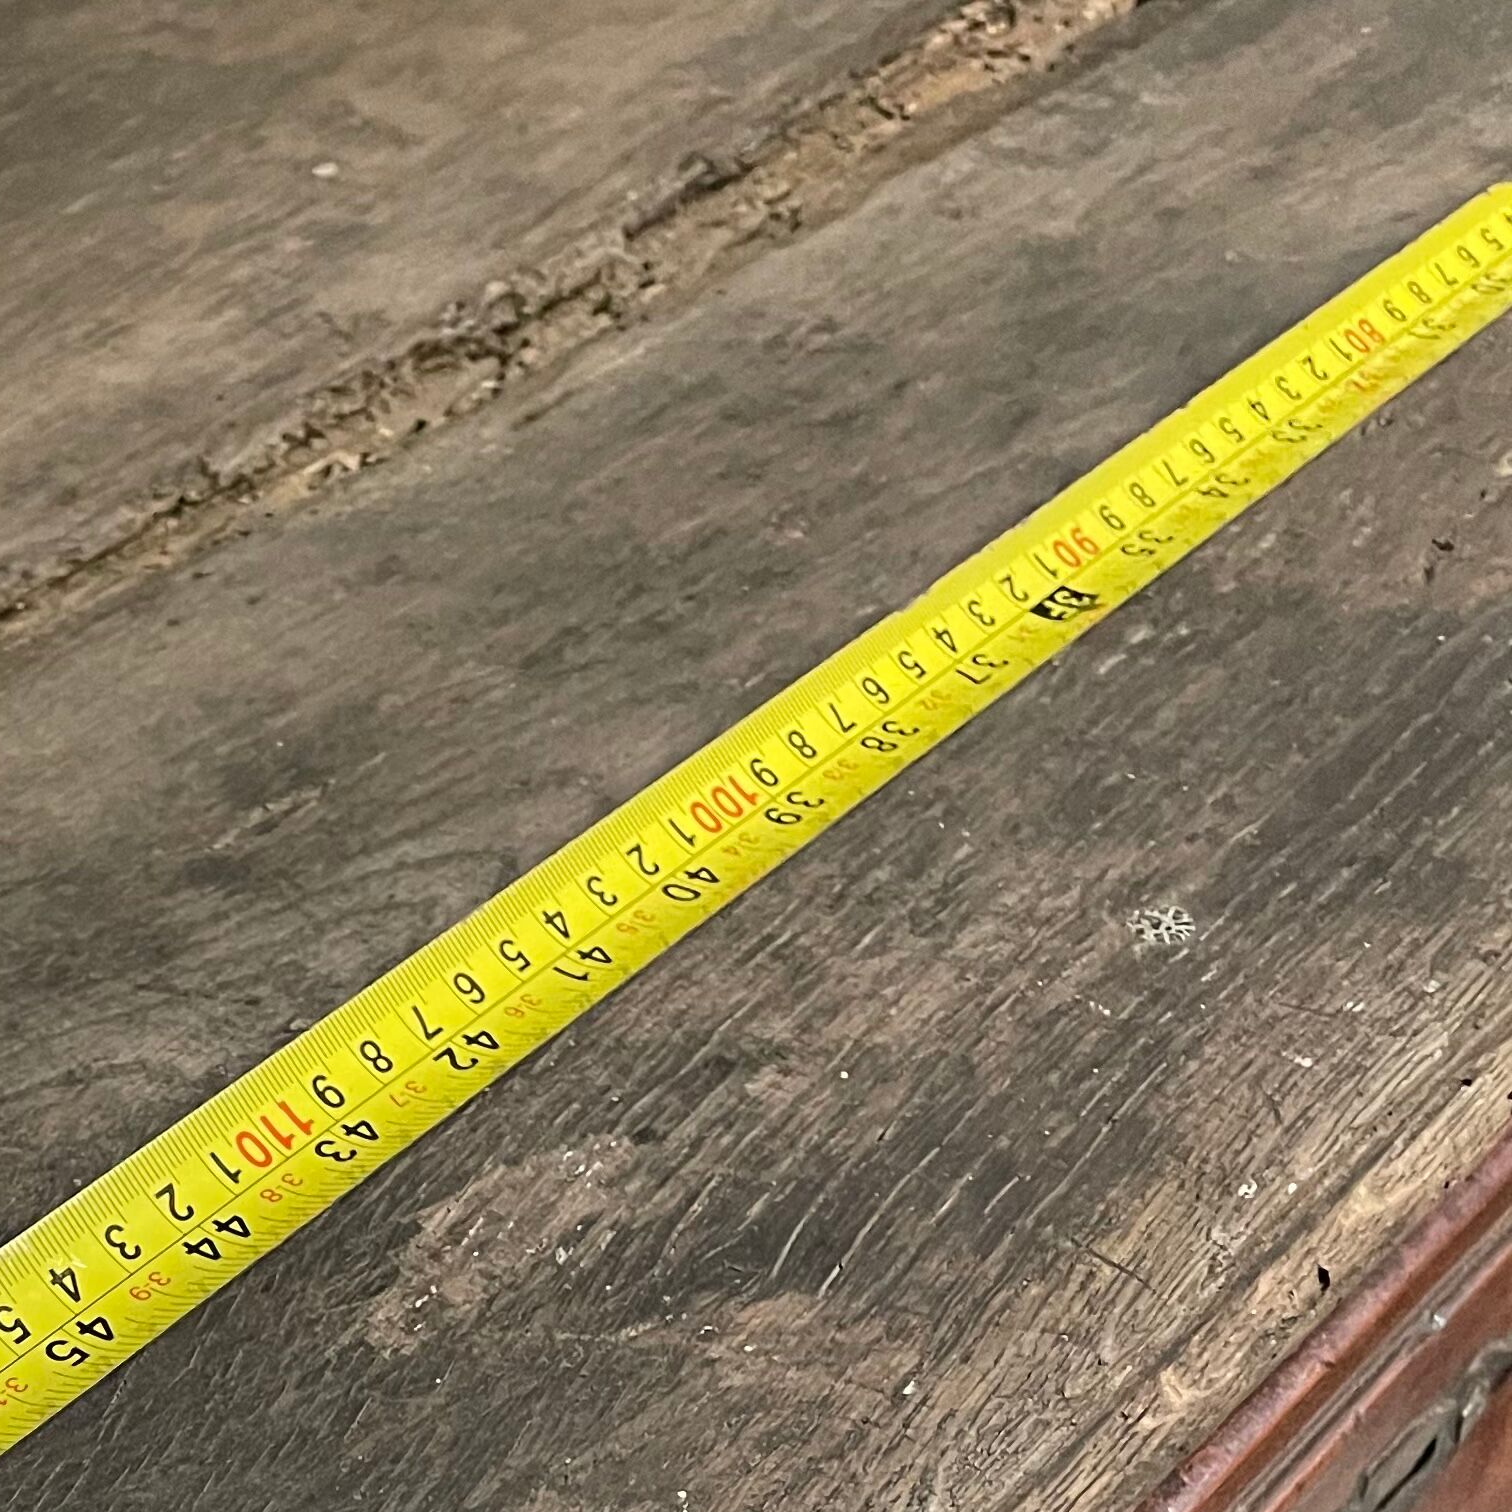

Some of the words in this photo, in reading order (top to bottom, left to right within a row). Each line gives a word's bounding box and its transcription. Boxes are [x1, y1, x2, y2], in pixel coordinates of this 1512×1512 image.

[1456, 245, 1481, 268] 6
[1434, 262, 1459, 286] 7
[1406, 280, 1433, 304] 8
[1382, 298, 1407, 322] 9
[1329, 337, 1353, 362] 1
[1343, 318, 1385, 353] 80
[1301, 355, 1328, 381] 2
[1274, 375, 1302, 400] 3
[1246, 397, 1271, 422] 4
[1218, 416, 1245, 443] 5
[1189, 438, 1215, 464] 6
[1162, 459, 1189, 487] 7
[1128, 482, 1157, 508] 8
[1098, 505, 1126, 531] 9
[1052, 525, 1101, 569] 90
[1033, 552, 1059, 580] 1
[998, 573, 1029, 602] 2
[967, 599, 996, 627] 3
[931, 626, 958, 653] 4
[897, 650, 927, 680] 5
[955, 653, 1010, 686] 37
[861, 676, 890, 705] 6
[828, 702, 858, 734] 7
[788, 730, 818, 760] 8
[860, 720, 920, 753] 38
[749, 757, 780, 788] 9
[689, 775, 759, 834] 100
[764, 791, 826, 826] 39
[667, 818, 696, 848] 1
[625, 842, 661, 877] 2
[586, 875, 619, 907] 3
[661, 866, 721, 902] 40
[542, 910, 571, 940] 4
[498, 939, 532, 973] 5
[553, 945, 614, 983] 41
[453, 972, 486, 1005] 6
[411, 1005, 445, 1041] 7
[359, 1040, 394, 1074] 8
[432, 1029, 501, 1071] 42
[311, 1074, 346, 1110] 9
[234, 1100, 314, 1169] 110
[313, 1119, 381, 1164] 43
[210, 1152, 243, 1185] 1
[155, 1183, 195, 1223] 2
[103, 1224, 143, 1261] 3
[181, 1214, 252, 1262] 44
[48, 1267, 82, 1304] 4
[44, 1315, 116, 1368] 45
